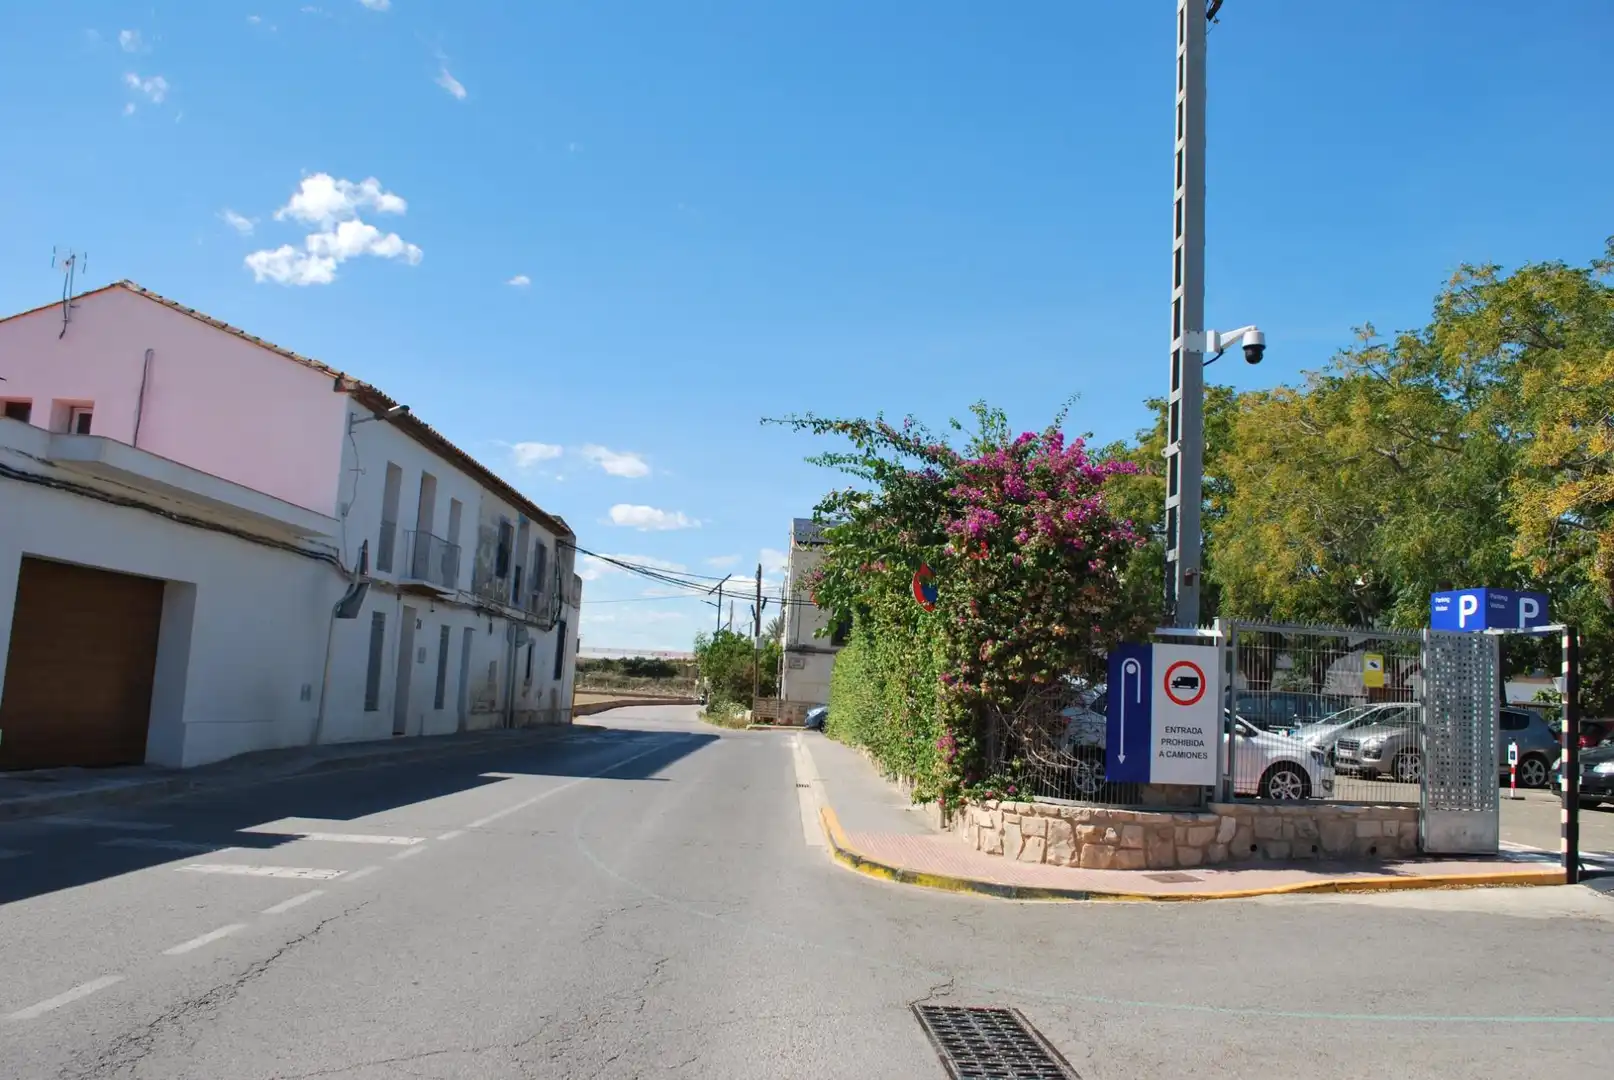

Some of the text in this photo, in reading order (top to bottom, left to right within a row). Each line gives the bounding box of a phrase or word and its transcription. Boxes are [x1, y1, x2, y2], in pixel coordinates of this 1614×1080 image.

[1459, 594, 1478, 628] P
[1519, 597, 1540, 630] P
[1165, 726, 1203, 735] ENTRADA
[1161, 738, 1204, 747] PROHIBIDA
[1166, 750, 1208, 760] CAMIONES
